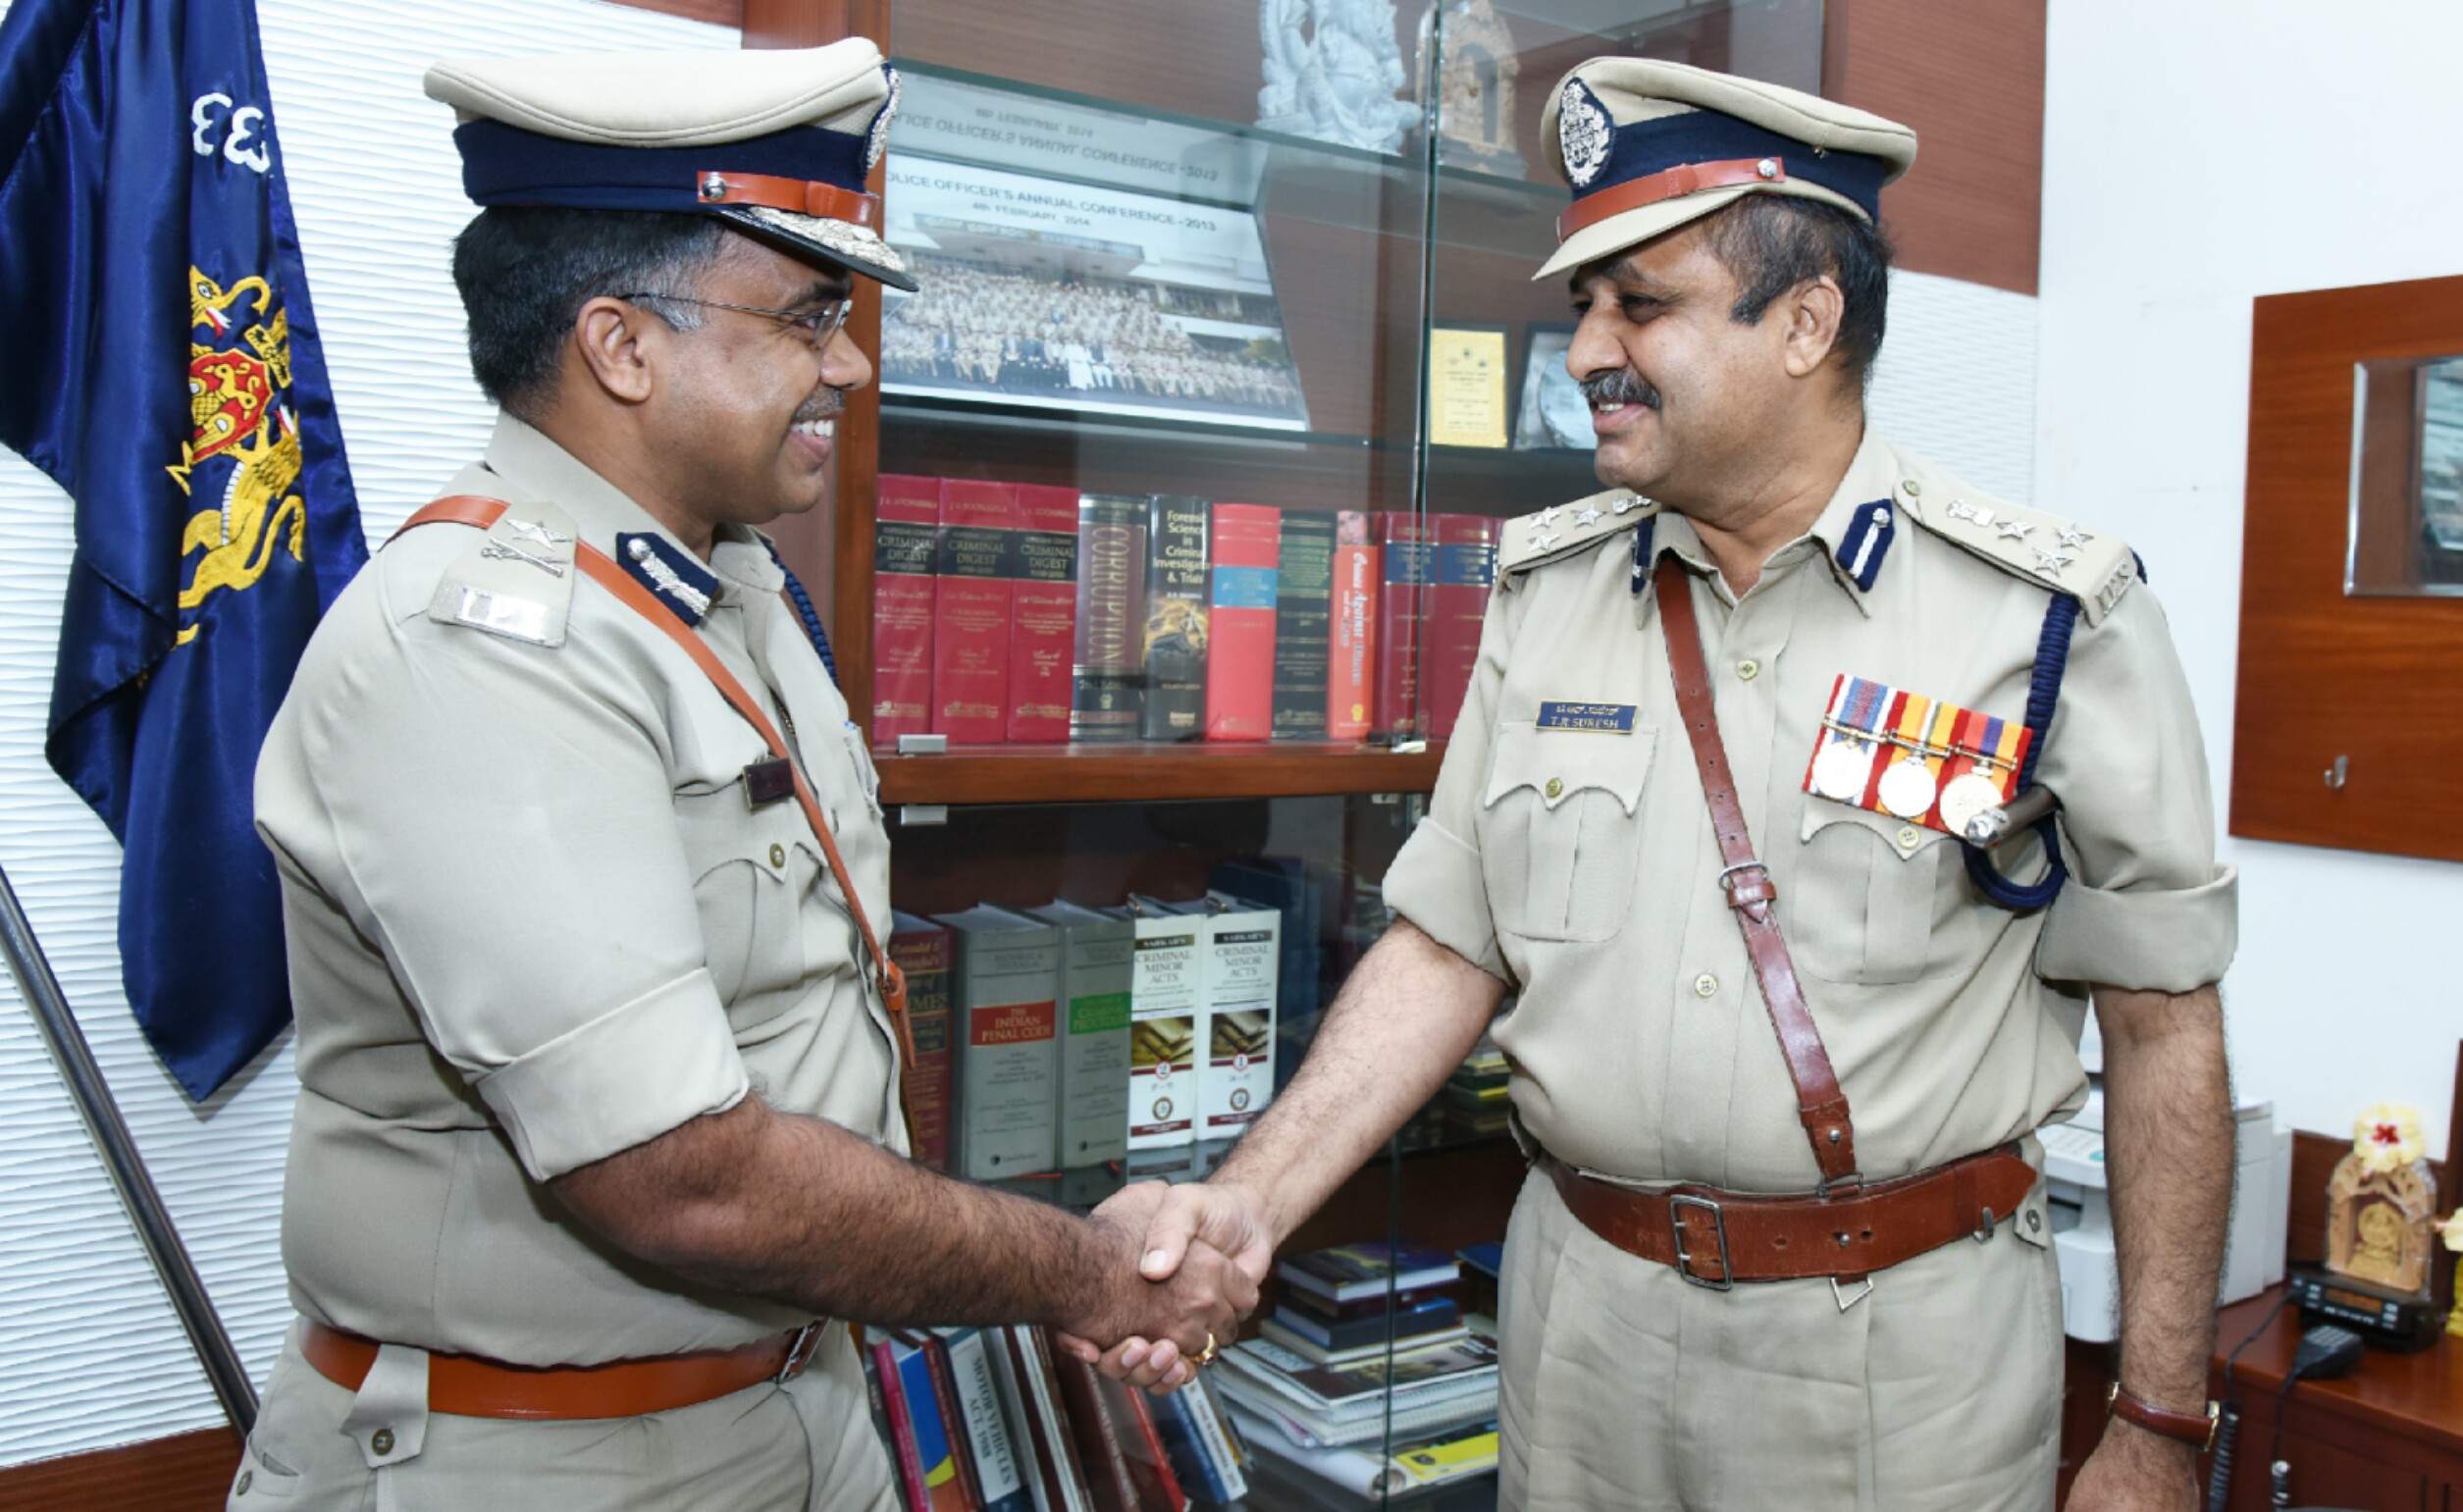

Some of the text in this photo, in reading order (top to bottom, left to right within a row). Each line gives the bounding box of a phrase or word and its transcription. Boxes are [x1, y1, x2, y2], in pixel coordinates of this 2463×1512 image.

[1018, 191, 1078, 209] ANNUAL
[1080, 201, 1176, 226] CONFERENCE
[878, 536, 936, 549] CRIMINAL
[947, 541, 1006, 555] CRIMINAL
[888, 549, 929, 562] DIGEST
[1021, 545, 1075, 557] CRIMINAL
[1165, 546, 1206, 557] Crimina
[957, 552, 997, 565] DIGEST
[1029, 557, 1068, 569] DIGEST
[1167, 571, 1178, 583] &
[1088, 527, 1130, 664] CORRUPTION
[1135, 950, 1192, 964] CRIMINAL
[1215, 944, 1271, 958] CRIMINAL
[1145, 962, 1183, 973] MINOR
[1225, 956, 1263, 967] MINOR
[1231, 966, 1258, 977] ACTS
[1151, 973, 1179, 984] ACTS
[995, 1016, 1041, 1029] INDIAN
[982, 1024, 1051, 1042] PENAL CODE
[972, 1356, 1014, 1486] MOTOR VEHICLES
[977, 1431, 992, 1460] 1988
